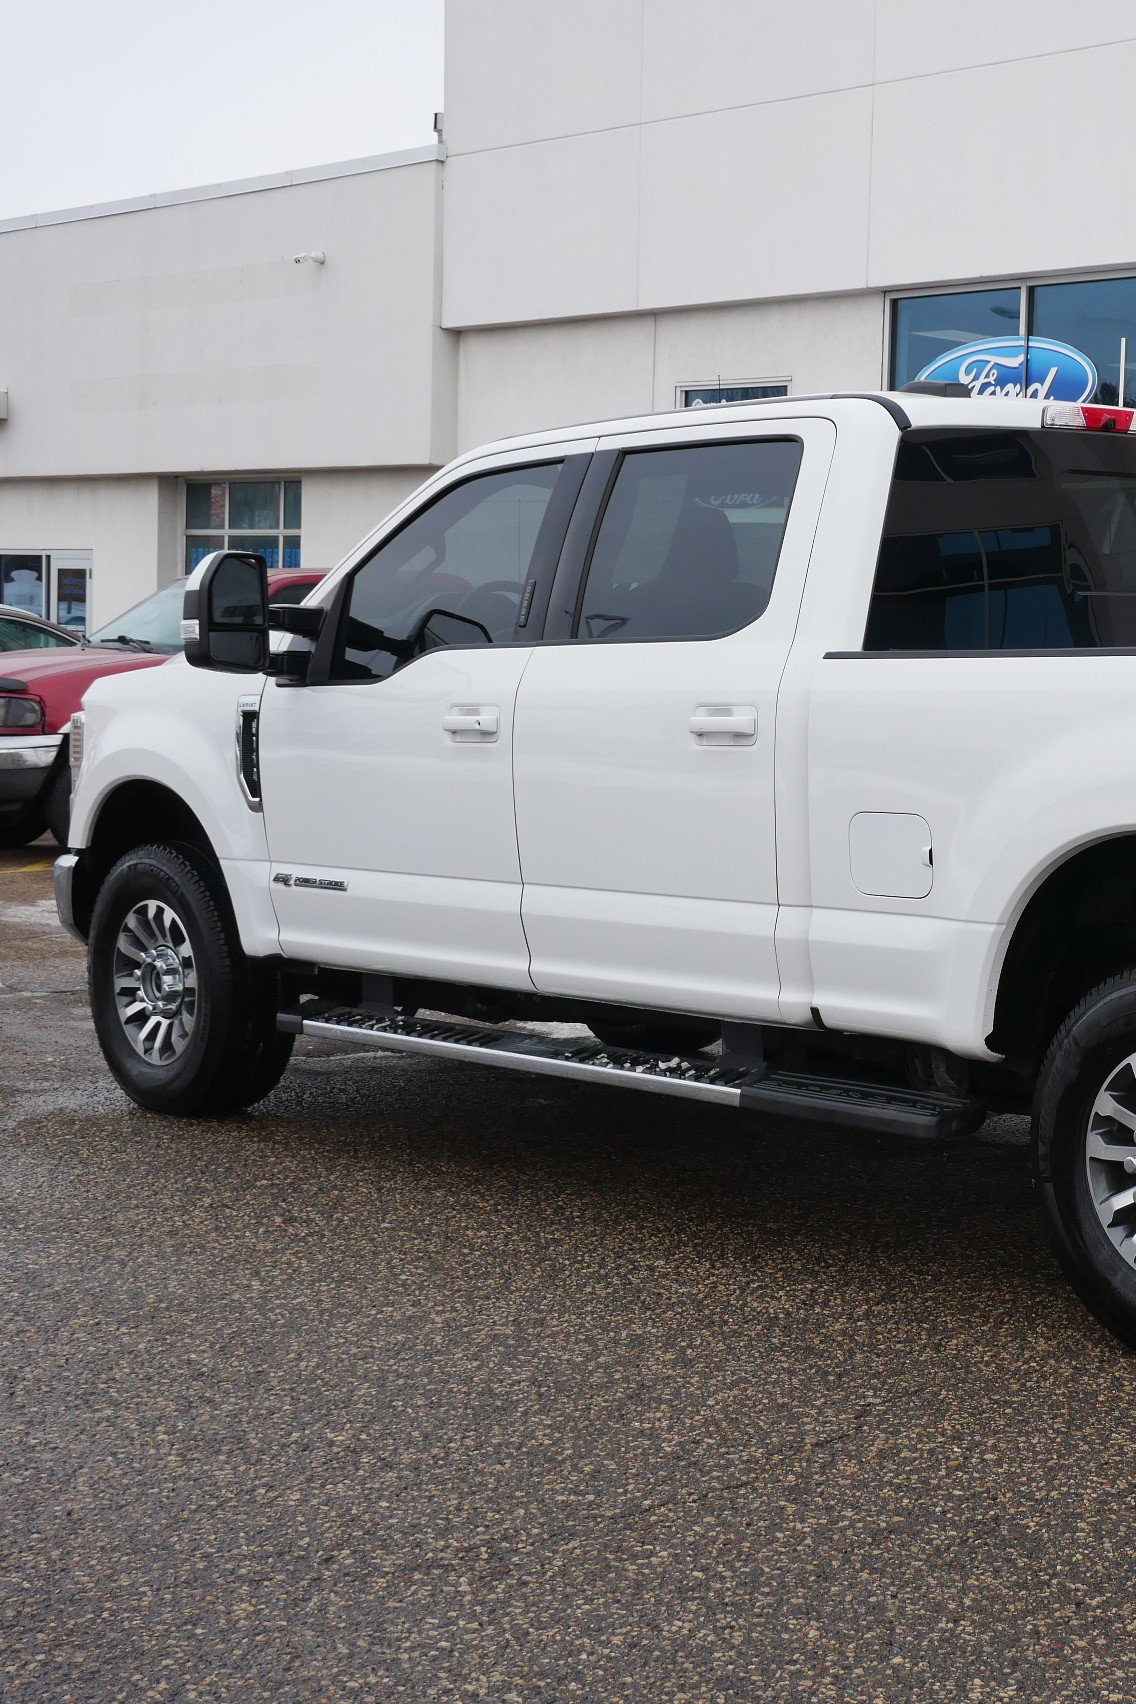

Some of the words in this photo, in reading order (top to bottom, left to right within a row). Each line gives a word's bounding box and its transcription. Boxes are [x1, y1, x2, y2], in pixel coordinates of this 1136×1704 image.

[958, 354, 1058, 400] Ford
[294, 876, 317, 885] POWER
[318, 878, 345, 888] STROKE
